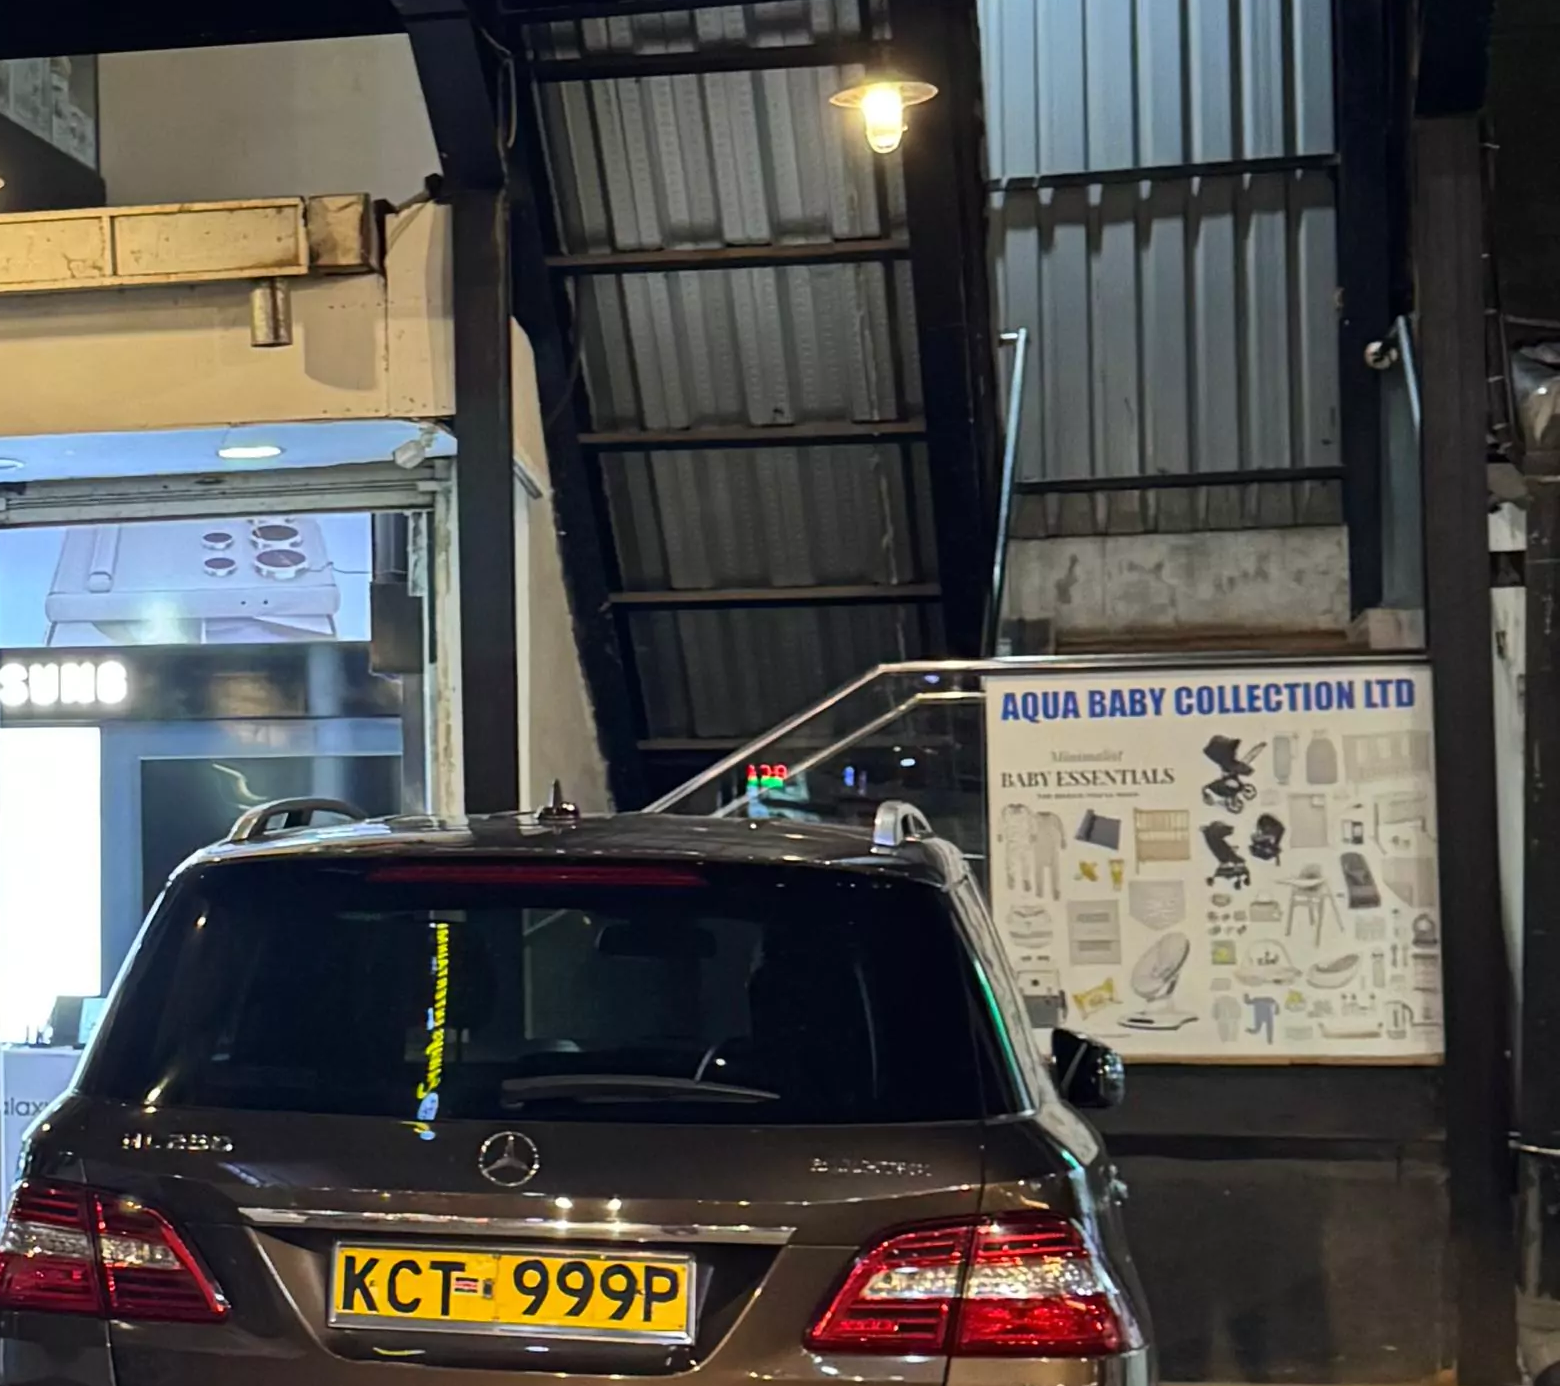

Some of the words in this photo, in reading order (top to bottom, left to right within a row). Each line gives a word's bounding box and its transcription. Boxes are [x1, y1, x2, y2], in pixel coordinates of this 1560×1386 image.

[1000, 692, 1081, 723] AQUA
[1087, 686, 1168, 718] BABY
[1173, 680, 1356, 716] COLLECTION
[1364, 678, 1417, 709] LTD
[1000, 771, 1052, 789] BABY
[1056, 767, 1176, 788] ESSENTIALS
[341, 1255, 466, 1318] KCT
[511, 1258, 680, 1323] 999P
